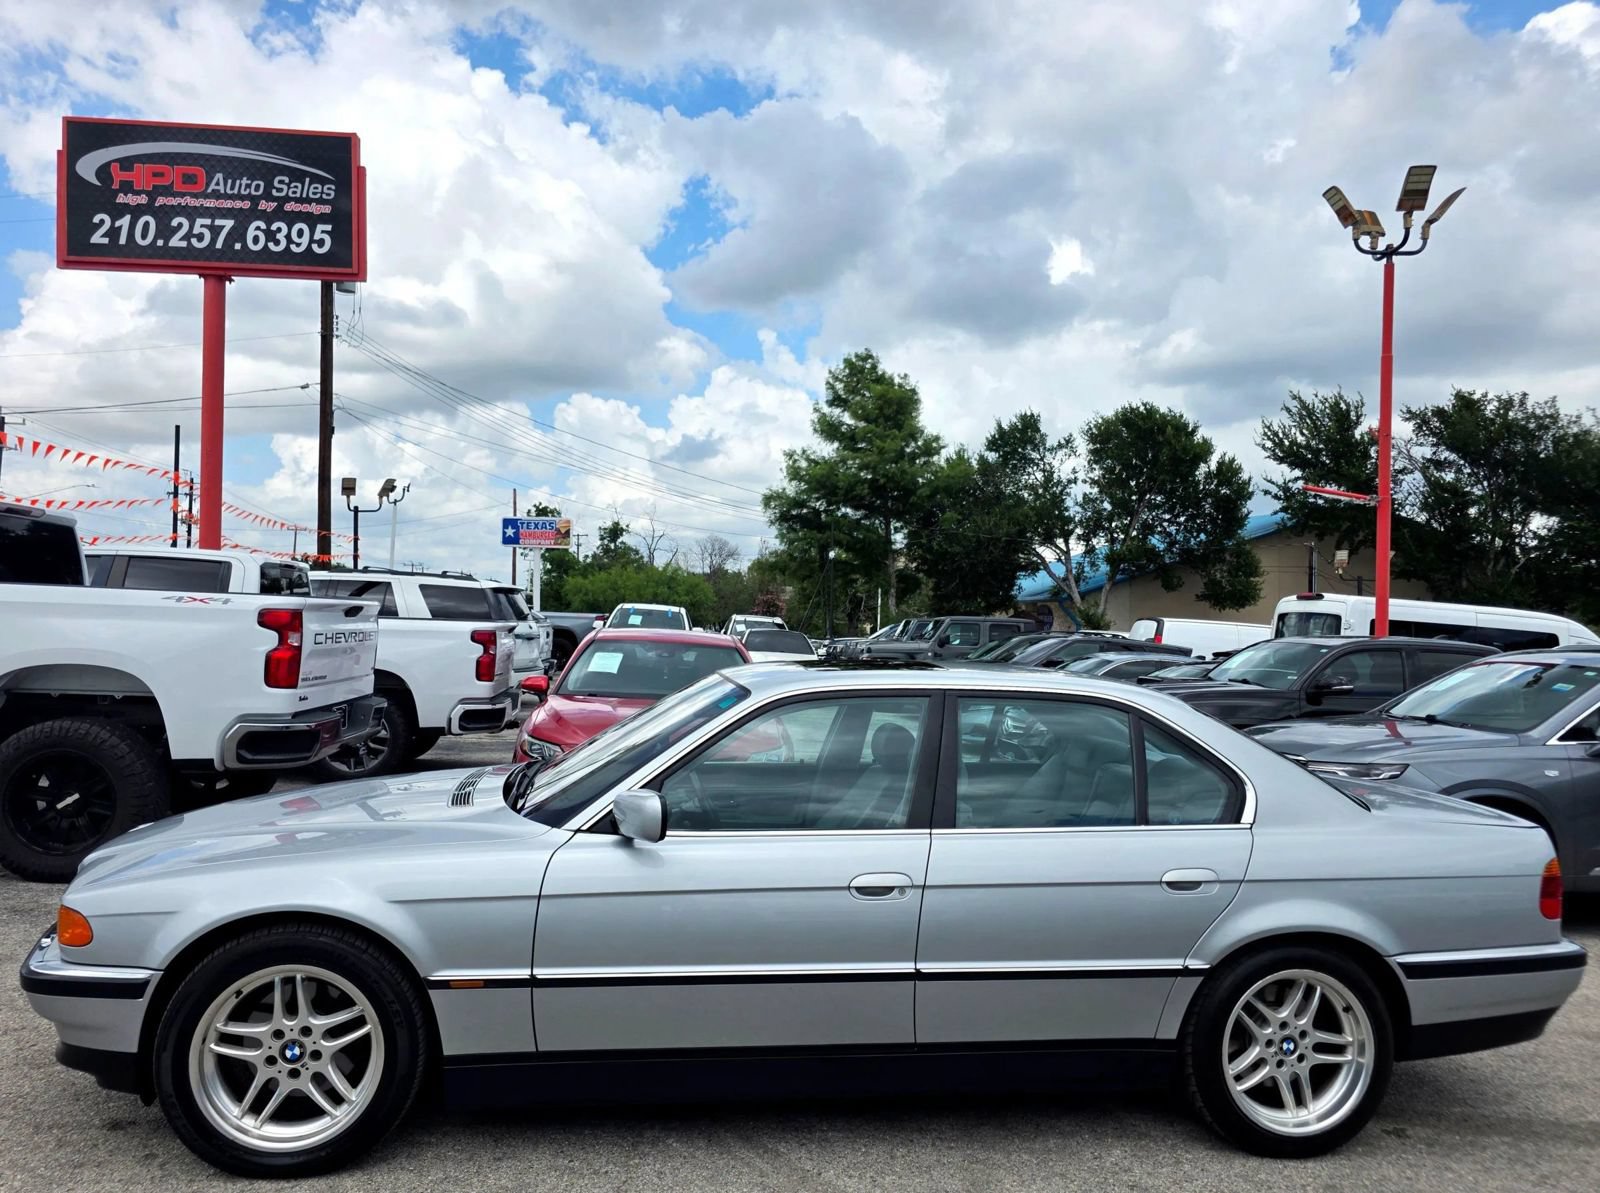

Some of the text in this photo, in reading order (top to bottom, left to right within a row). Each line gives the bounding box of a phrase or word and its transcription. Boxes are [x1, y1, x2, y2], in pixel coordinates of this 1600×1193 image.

[110, 162, 336, 200] HPD Auto Sales
[116, 193, 332, 214] high performance by design
[90, 213, 332, 254] 210.257.6395
[518, 521, 555, 530] TEXAS
[313, 630, 378, 645] CHEVROLET
